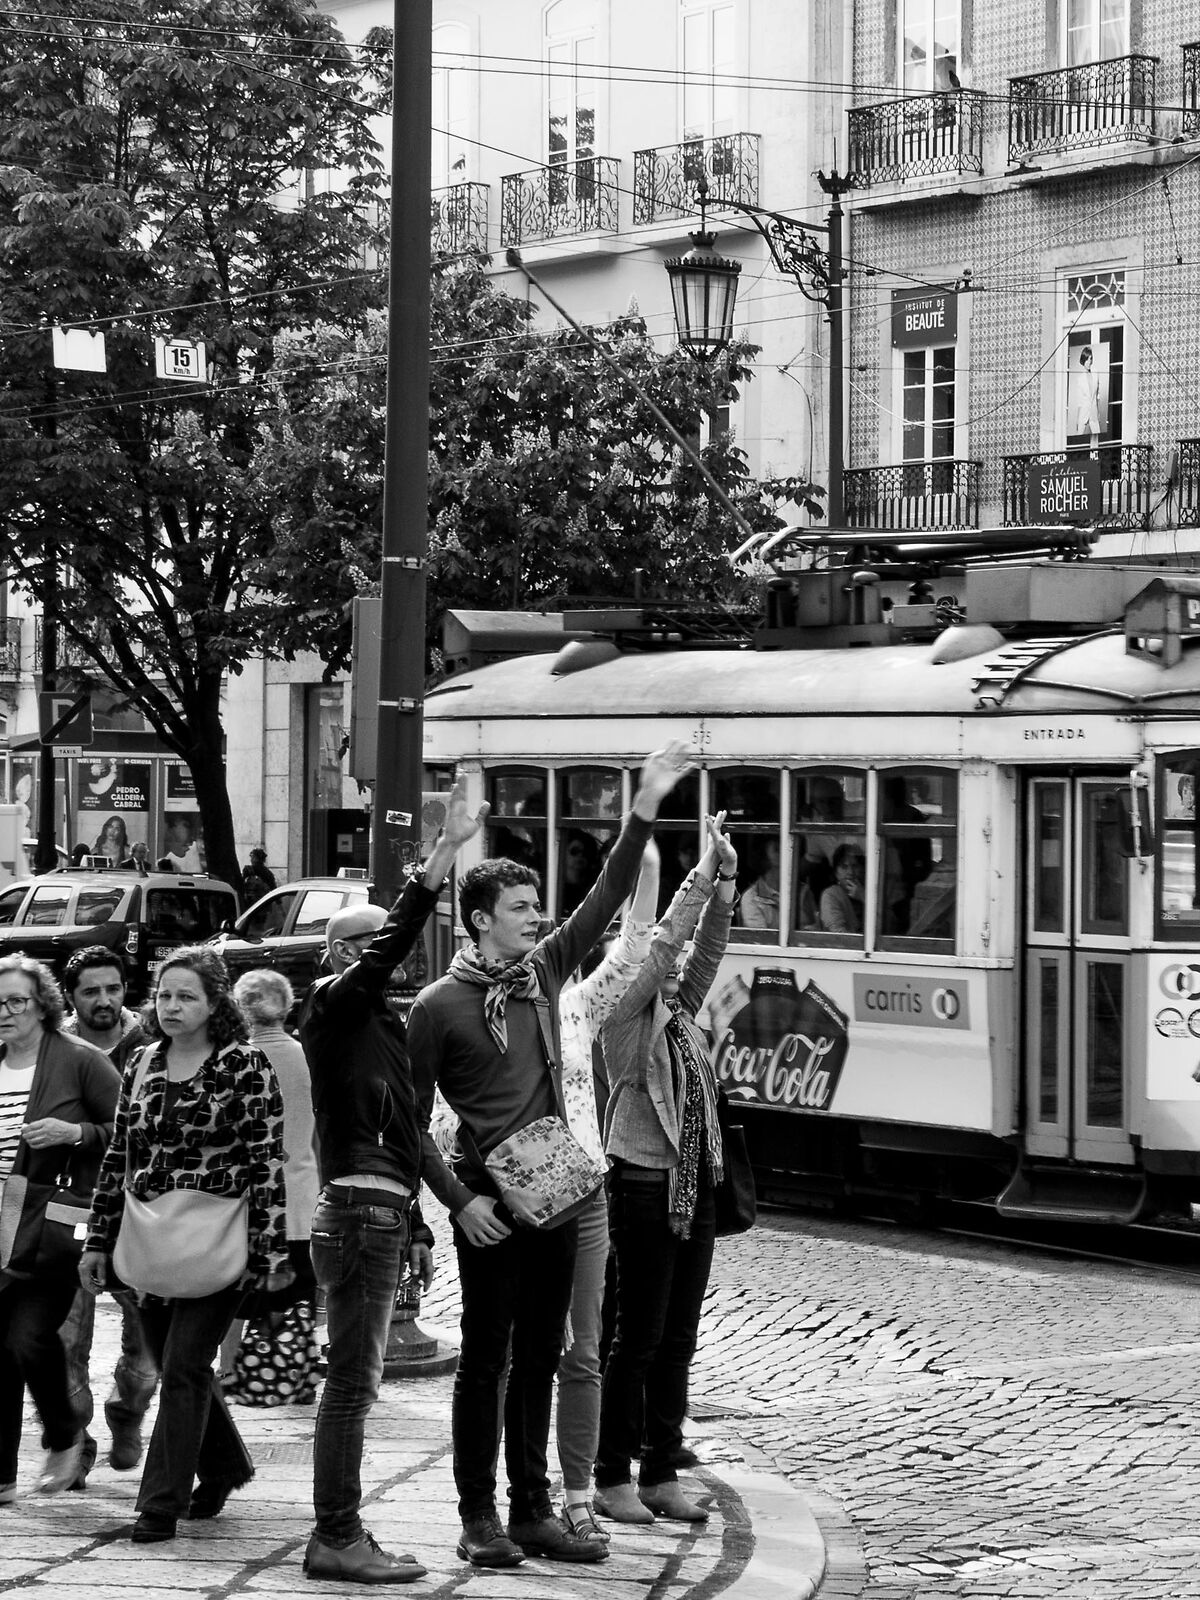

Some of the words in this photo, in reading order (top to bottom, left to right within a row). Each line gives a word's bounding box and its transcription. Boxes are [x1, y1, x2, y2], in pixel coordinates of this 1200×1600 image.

[937, 299, 945, 307] DE
[905, 307, 945, 332] BEAUTÉ
[171, 348, 190, 367] 15
[1041, 476, 1088, 496] SAMUEL
[1041, 494, 1088, 513] ROCHER
[1024, 729, 1086, 740] ENTRADA
[110, 793, 146, 801] CALDEIRA
[116, 786, 140, 794] PEDRO
[866, 983, 922, 1014] carris
